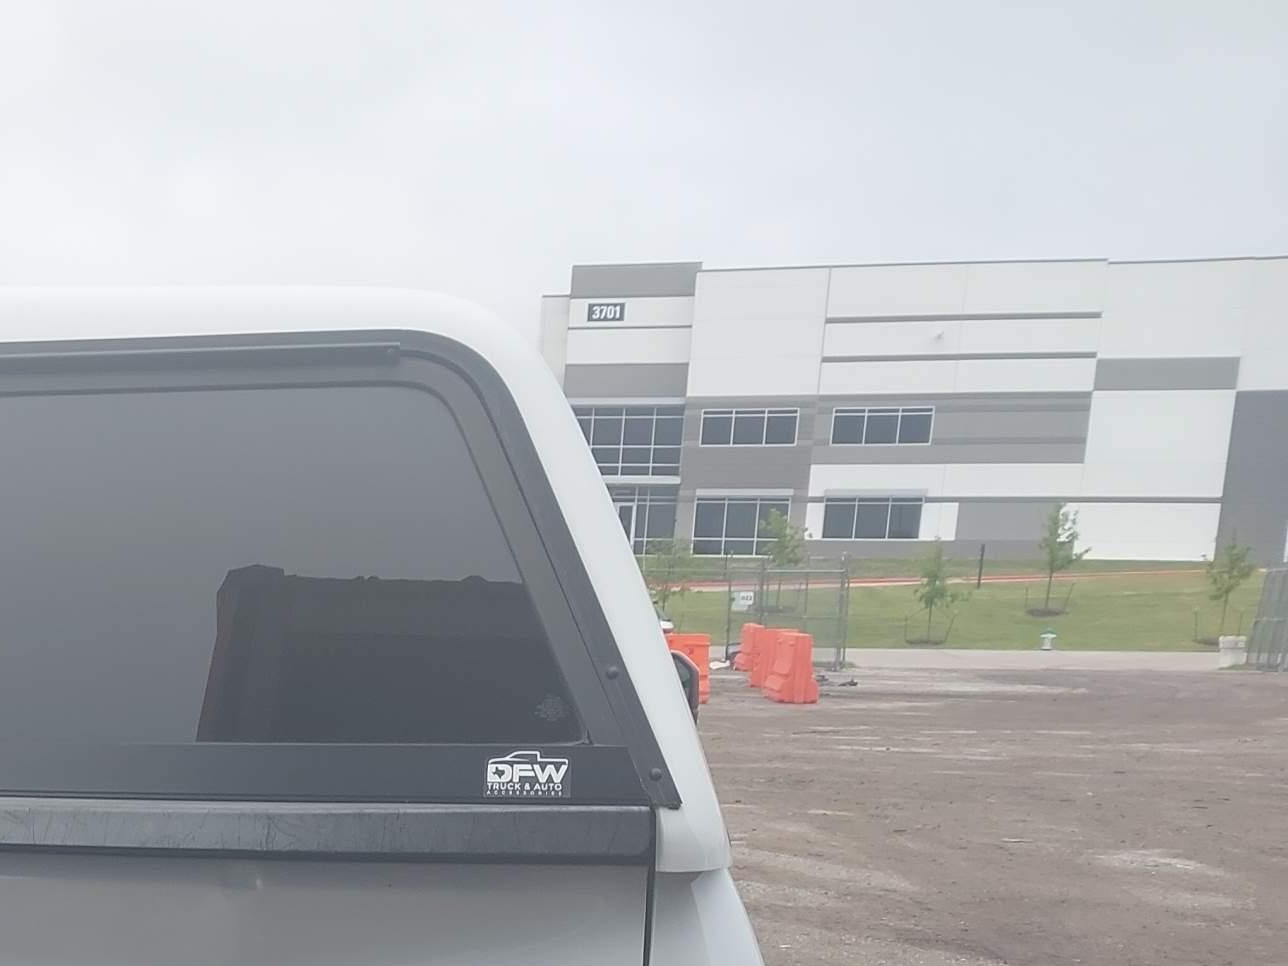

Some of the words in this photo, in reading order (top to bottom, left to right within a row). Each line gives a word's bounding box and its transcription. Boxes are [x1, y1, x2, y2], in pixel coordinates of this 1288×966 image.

[591, 305, 621, 320] 3701
[487, 763, 569, 783] DFW
[487, 782, 521, 791] TRUCK
[524, 782, 531, 791] &
[533, 783, 562, 791] AUTO
